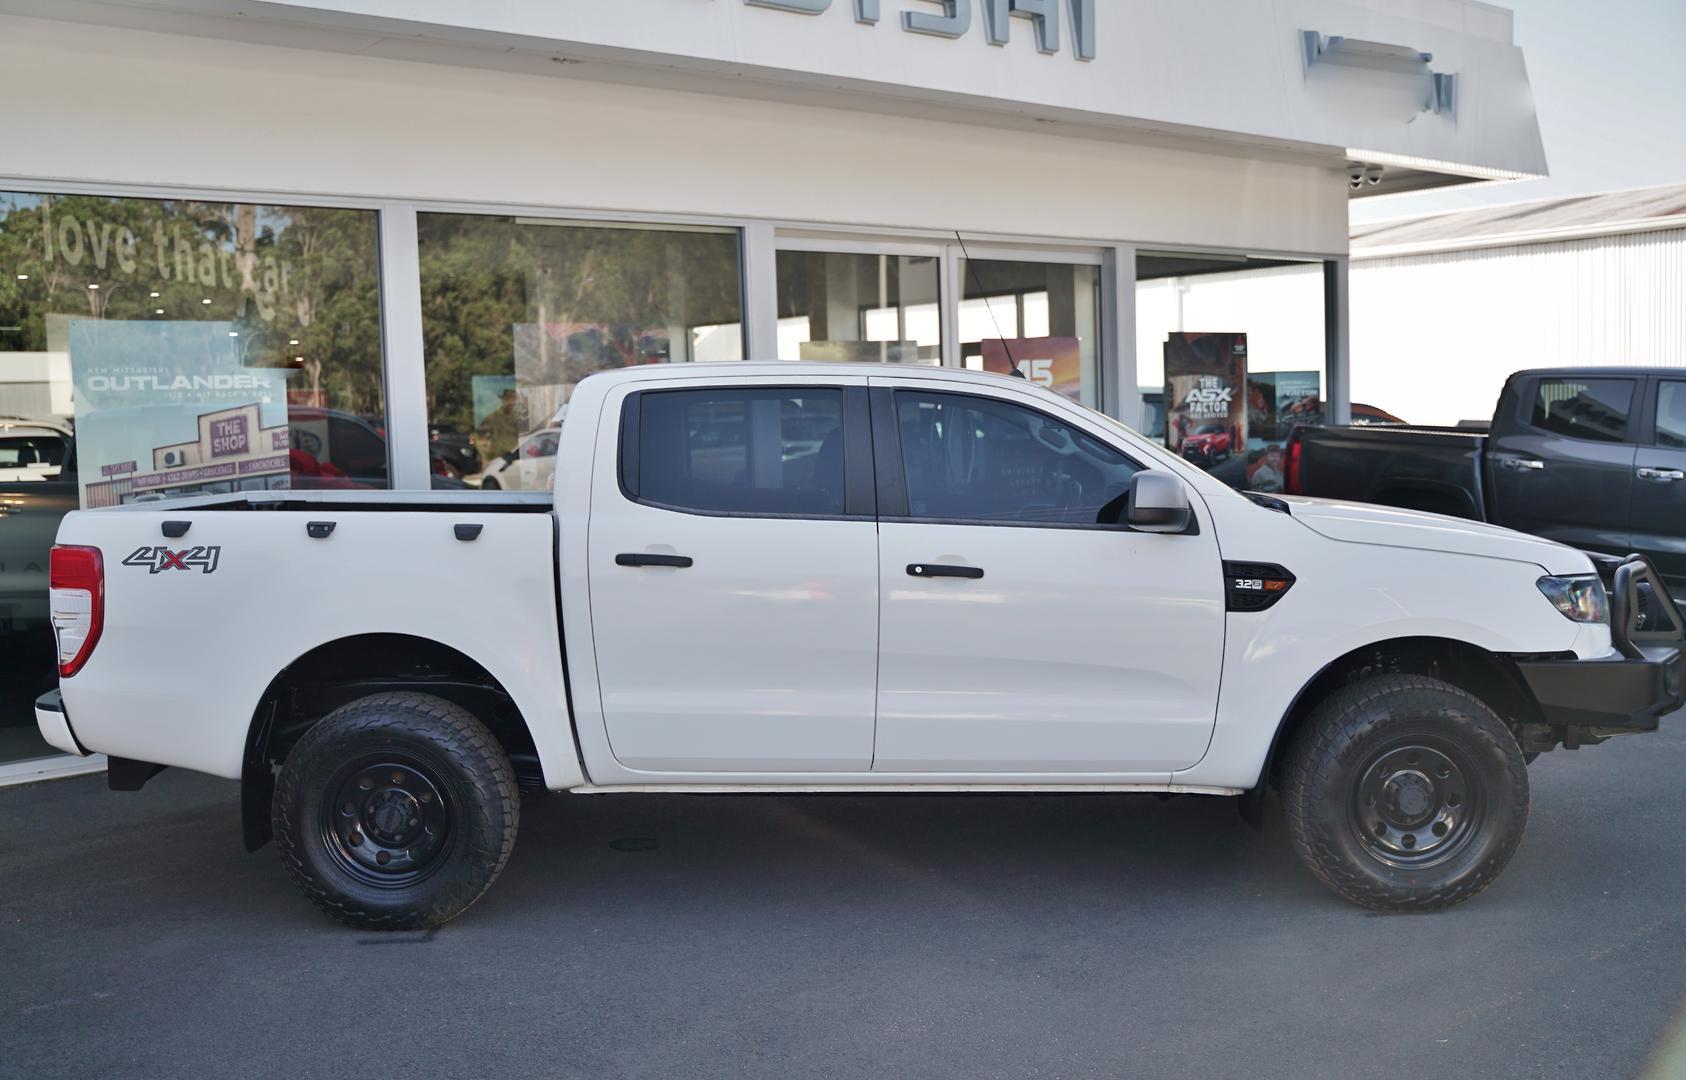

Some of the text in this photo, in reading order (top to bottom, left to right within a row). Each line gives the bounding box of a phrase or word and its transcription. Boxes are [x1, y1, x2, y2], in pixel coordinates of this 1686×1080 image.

[87, 374, 272, 392] OUTLANDER
[1199, 377, 1219, 389] THE
[1185, 387, 1233, 403] ASX
[1189, 401, 1229, 413] FACTOR
[216, 418, 241, 437] THE
[213, 433, 246, 453] SHOP
